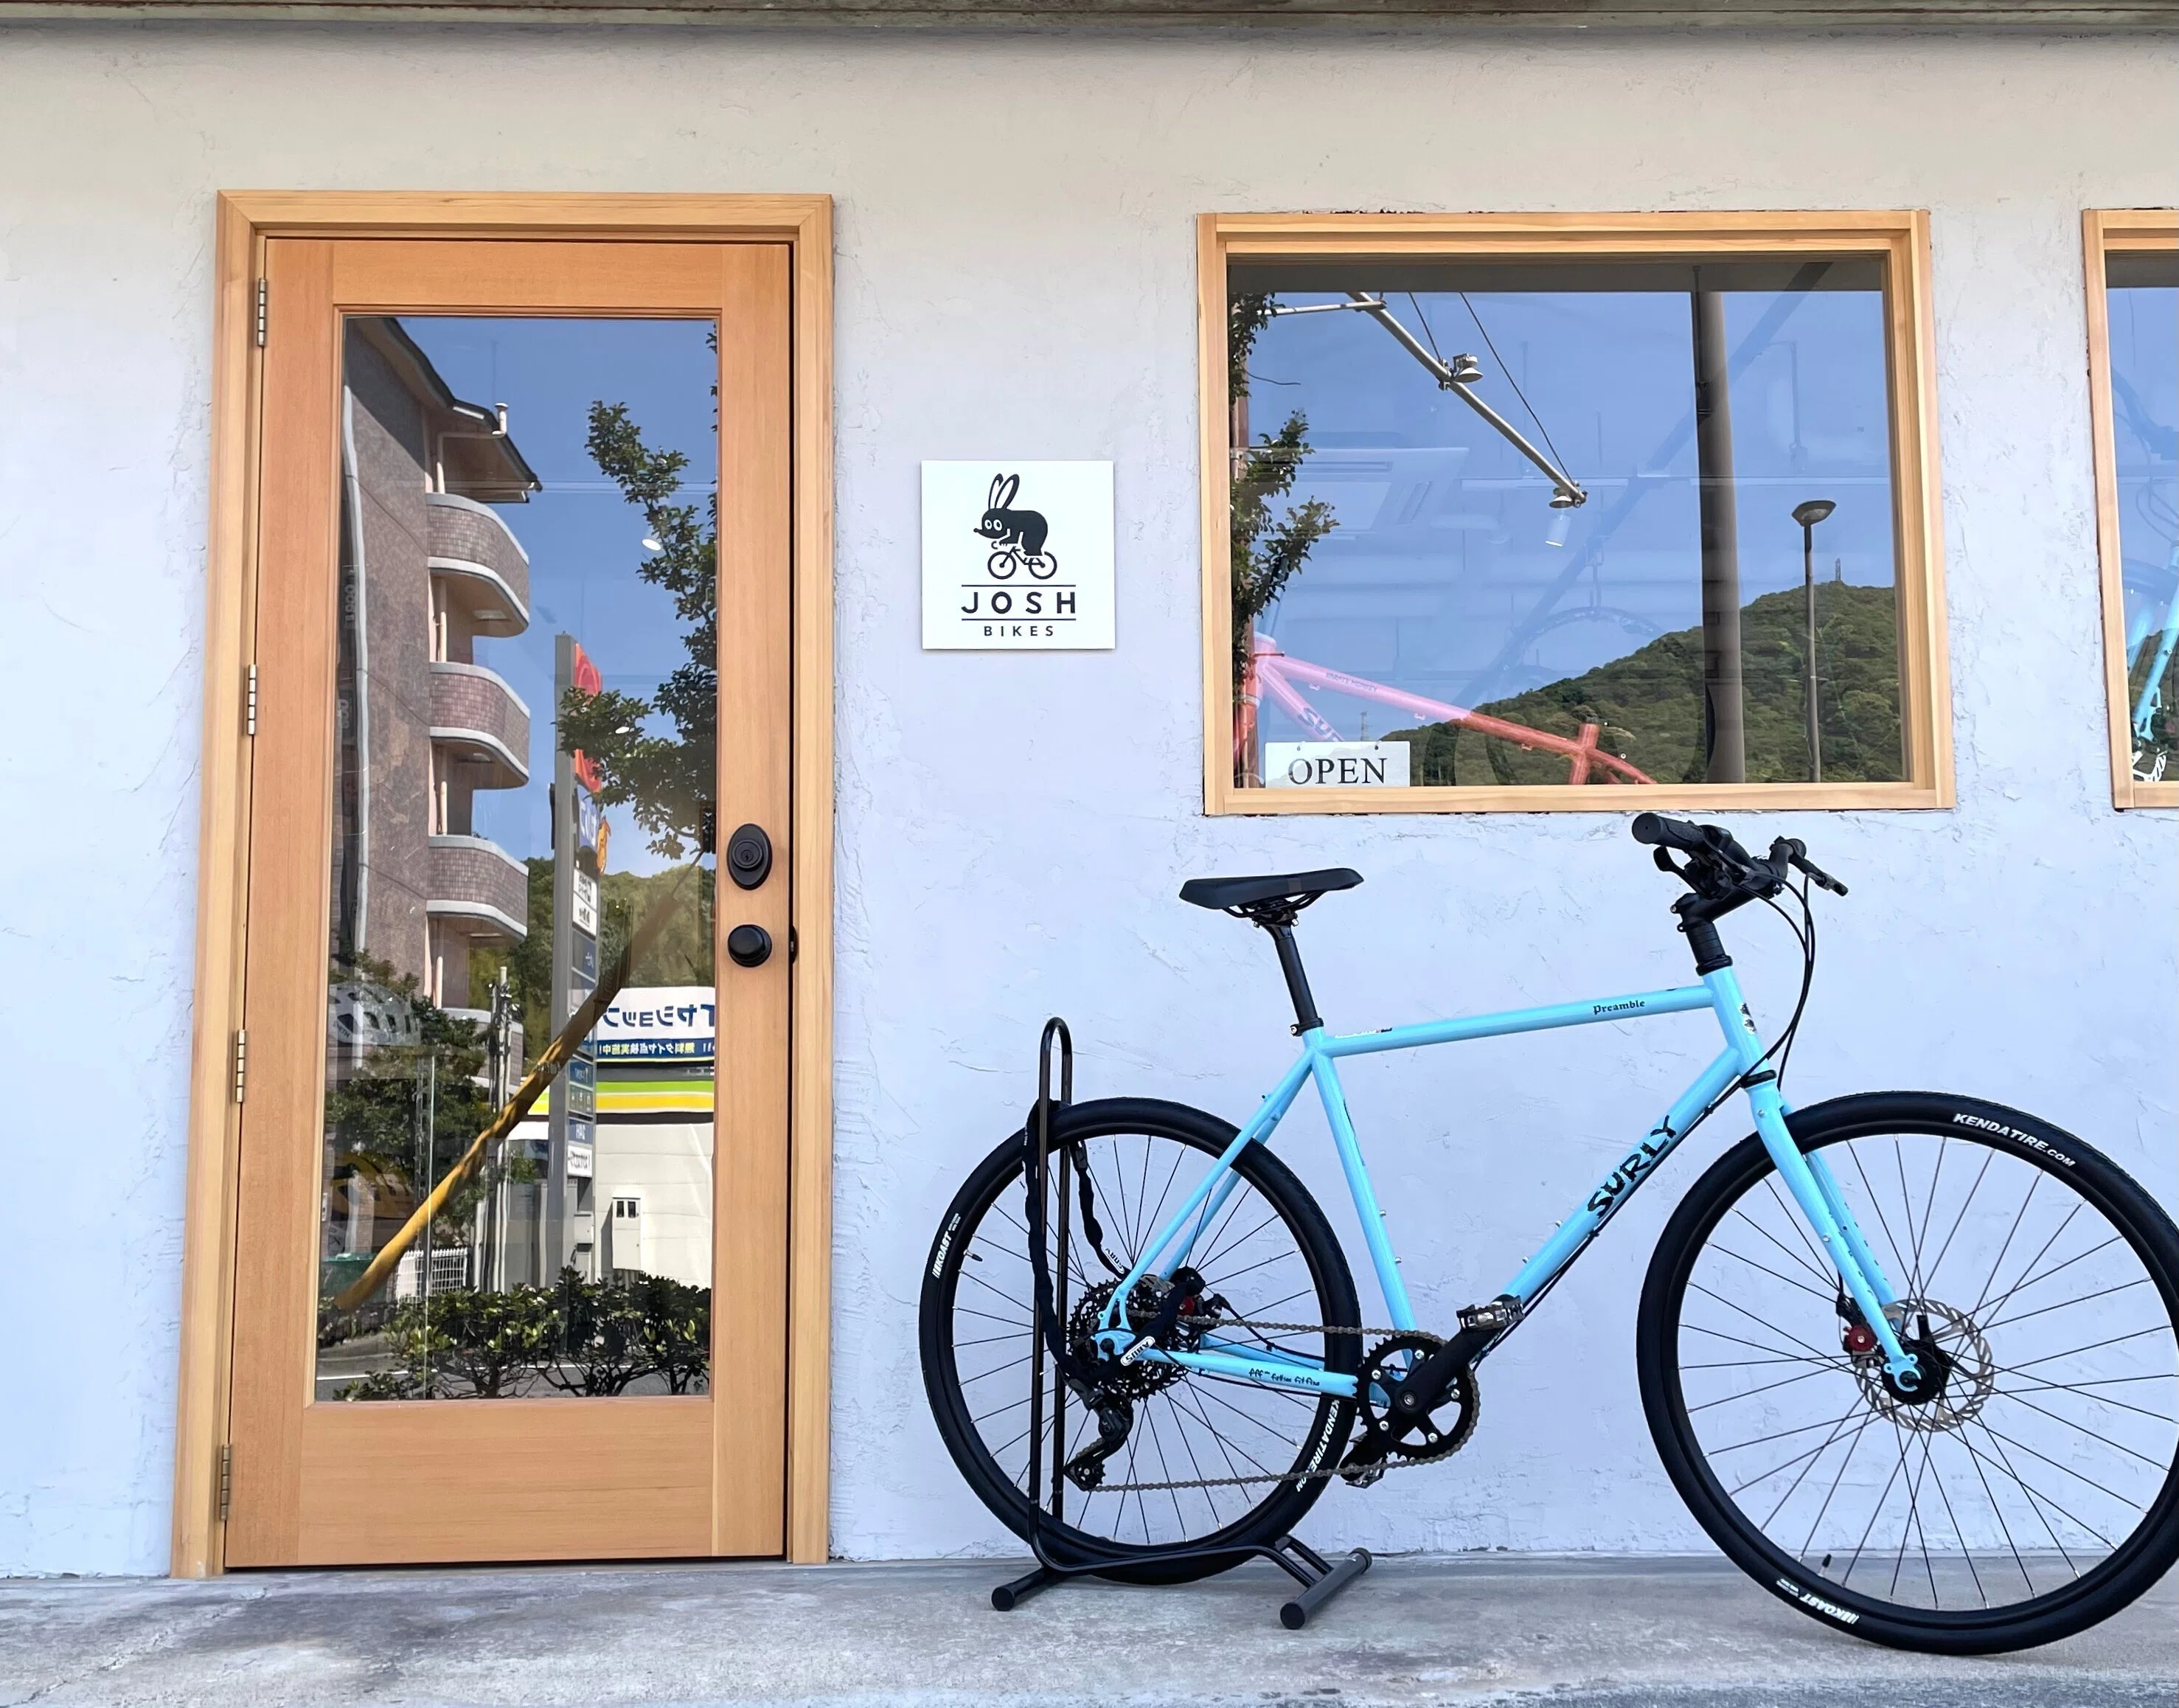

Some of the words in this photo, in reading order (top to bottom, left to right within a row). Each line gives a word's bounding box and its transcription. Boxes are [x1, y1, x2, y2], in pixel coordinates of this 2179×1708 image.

[961, 591, 1076, 614] JOSH
[984, 625, 1054, 636] BIKES
[1288, 758, 1388, 785] OPEN
[1593, 999, 1645, 1015] Preamble
[1953, 1112, 2077, 1167] KENDATIRE.COM
[1587, 1114, 1677, 1219] SURLY
[934, 1231, 952, 1271] KOAST
[1125, 1341, 1150, 1362] ABUS
[1799, 1593, 1850, 1622] KOAST
